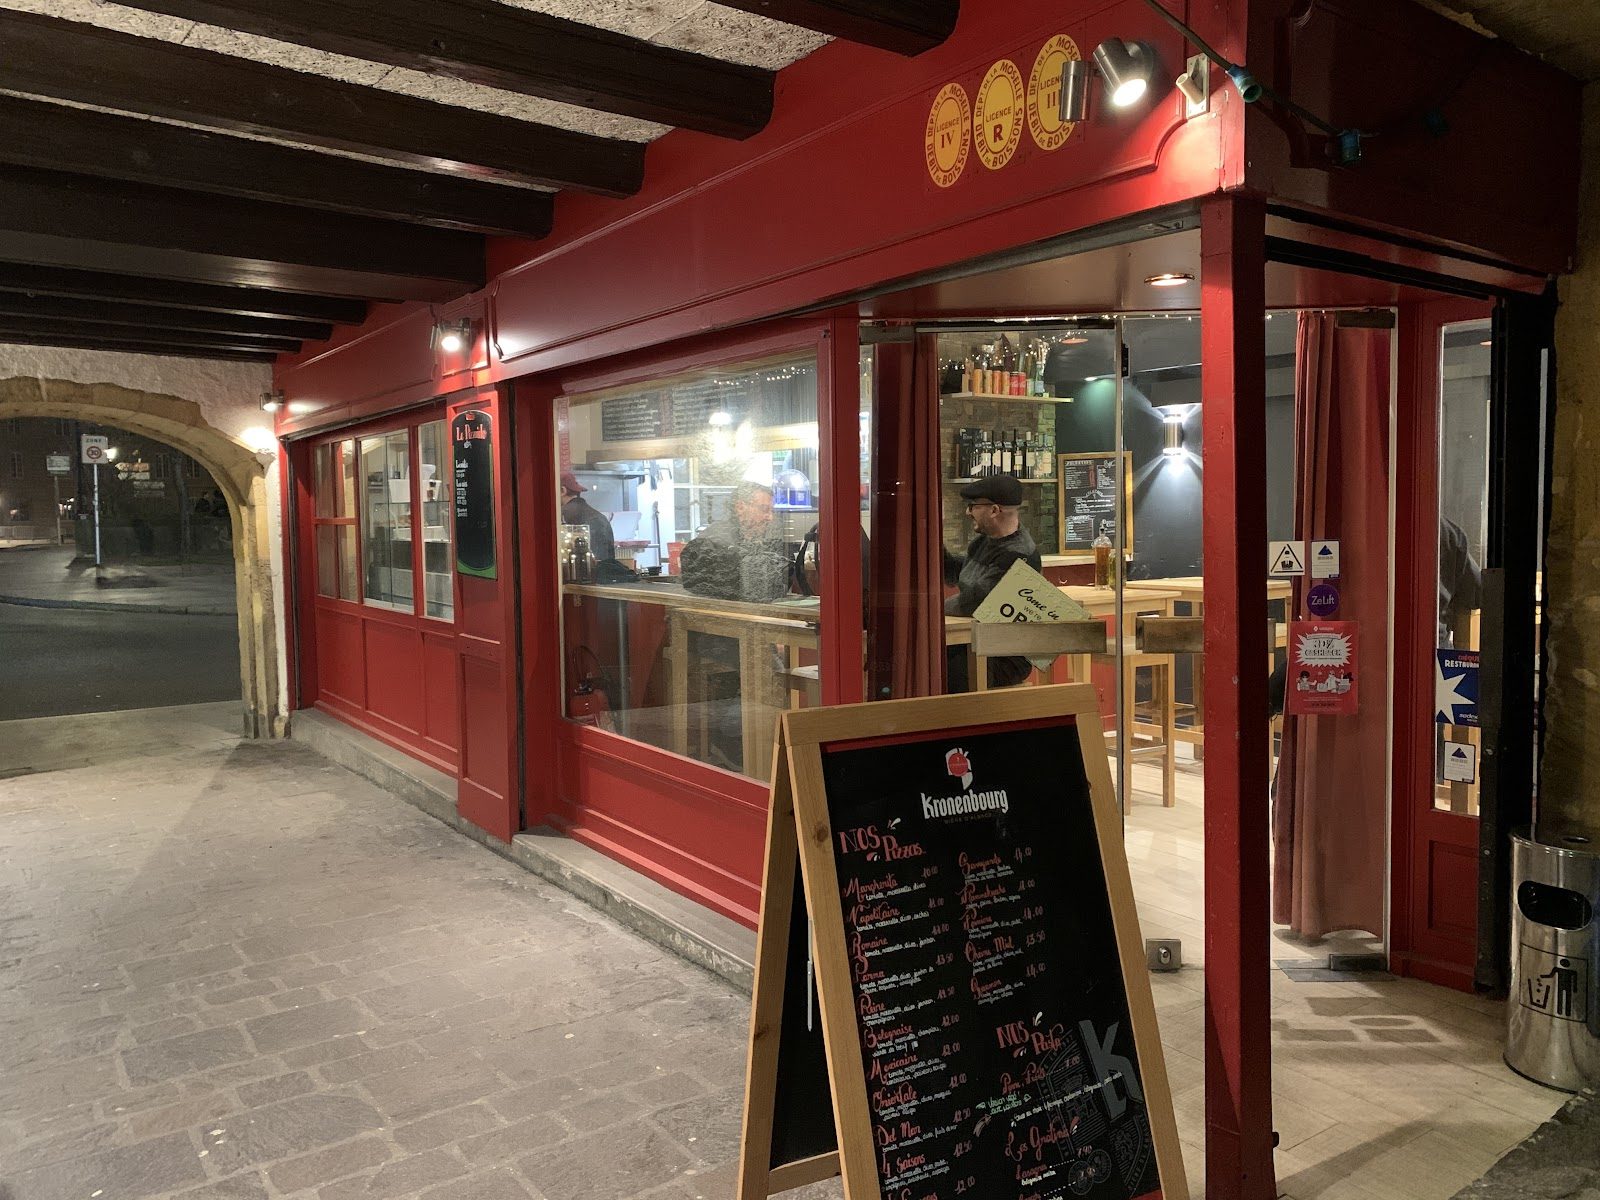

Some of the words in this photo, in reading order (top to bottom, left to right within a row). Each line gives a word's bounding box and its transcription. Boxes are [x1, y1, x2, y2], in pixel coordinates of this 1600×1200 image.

[1056, 36, 1081, 61] MOSE
[1000, 61, 1023, 101] MOSELLE
[1041, 75, 1062, 91] LICEN
[949, 84, 970, 122] MOSELLE
[985, 105, 1012, 123] LICENCE
[937, 117, 960, 133] LICENCE
[991, 107, 1023, 168] BOISSONS
[993, 123, 1004, 144] R
[1047, 121, 1076, 149] BOIS
[941, 129, 955, 149] IV
[942, 129, 970, 186] BOISSONS
[1018, 588, 1047, 611] Come
[1047, 611, 1060, 621] in
[920, 789, 1008, 819] Kronenbourg
[838, 824, 880, 854] NOS
[859, 993, 886, 1015] Reine
[996, 1020, 1030, 1048] NOS
[878, 1124, 896, 1146] Del
[896, 1152, 926, 1174] Saisons
